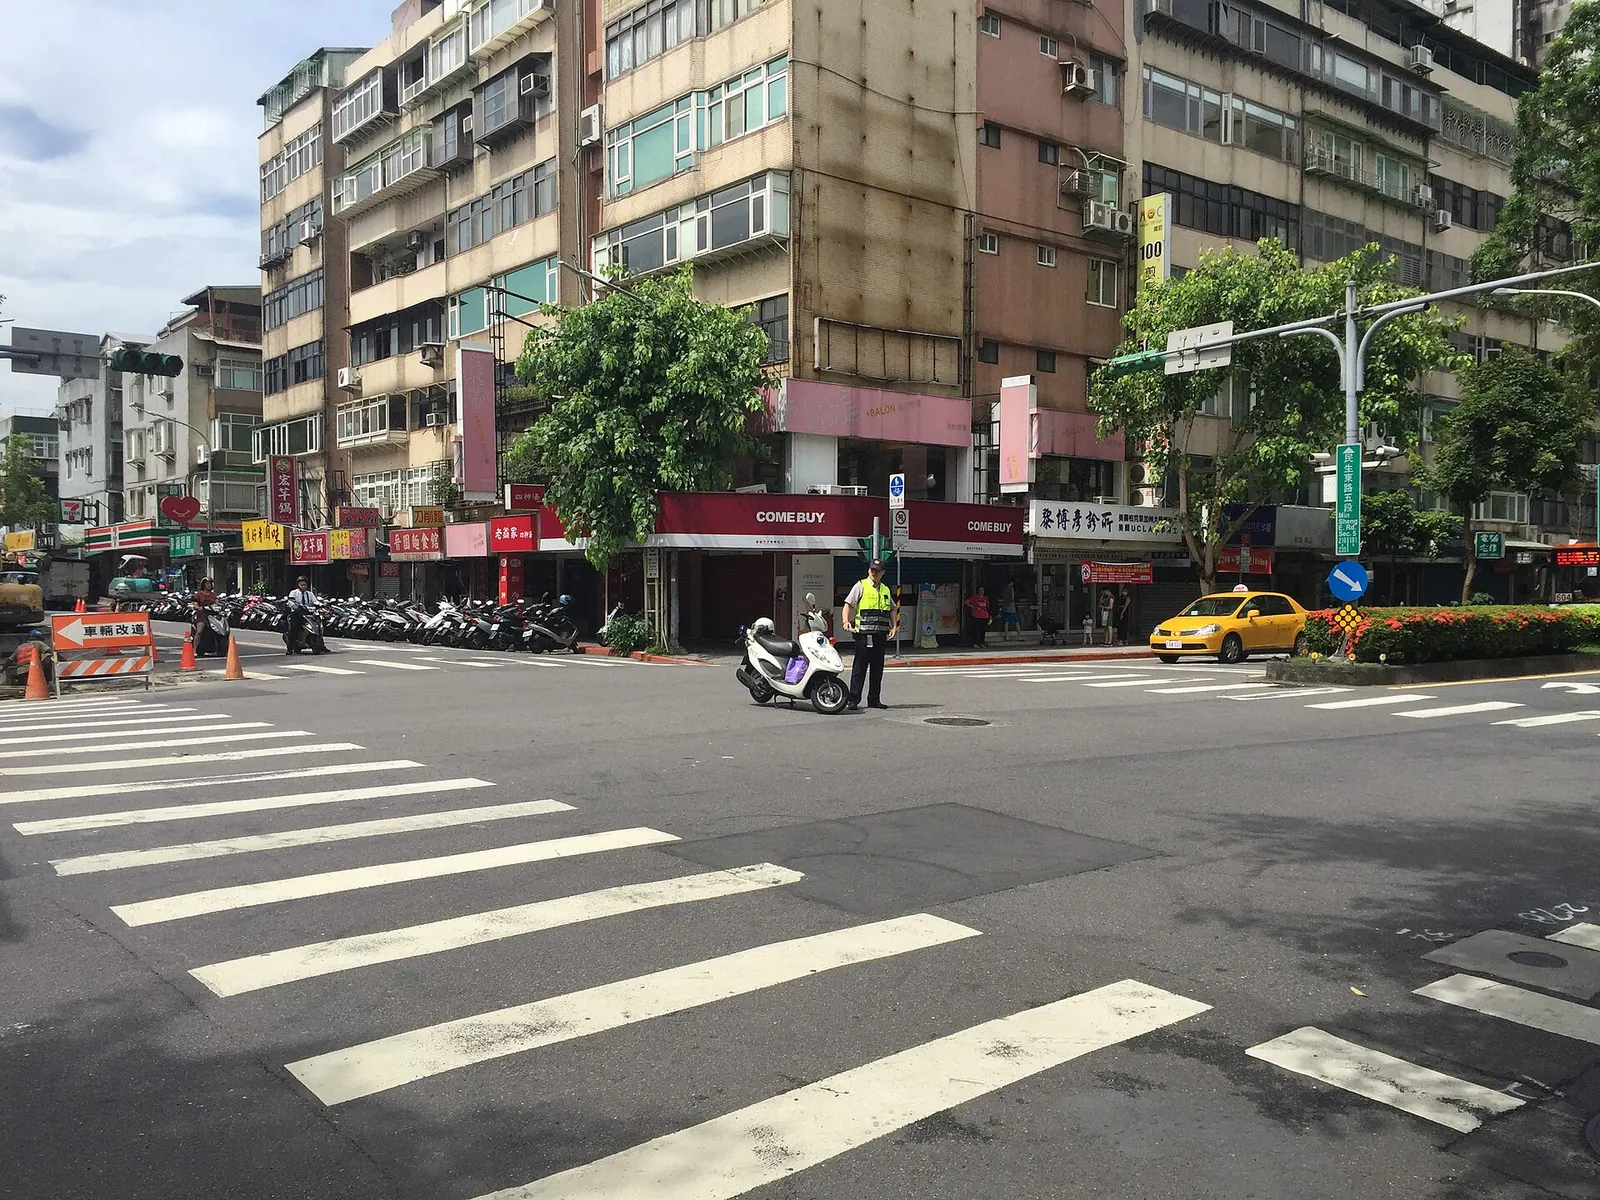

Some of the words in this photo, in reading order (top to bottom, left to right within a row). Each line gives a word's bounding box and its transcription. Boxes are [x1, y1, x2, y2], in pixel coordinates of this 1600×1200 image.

[1140, 241, 1162, 261] 100
[870, 404, 896, 418] SALON
[1343, 453, 1354, 512] 民生東路五段
[756, 511, 825, 523] COMEBUY
[967, 521, 1012, 533] COMEBUY
[1556, 593, 1572, 601] 604
[83, 623, 145, 637] 車輛改道
